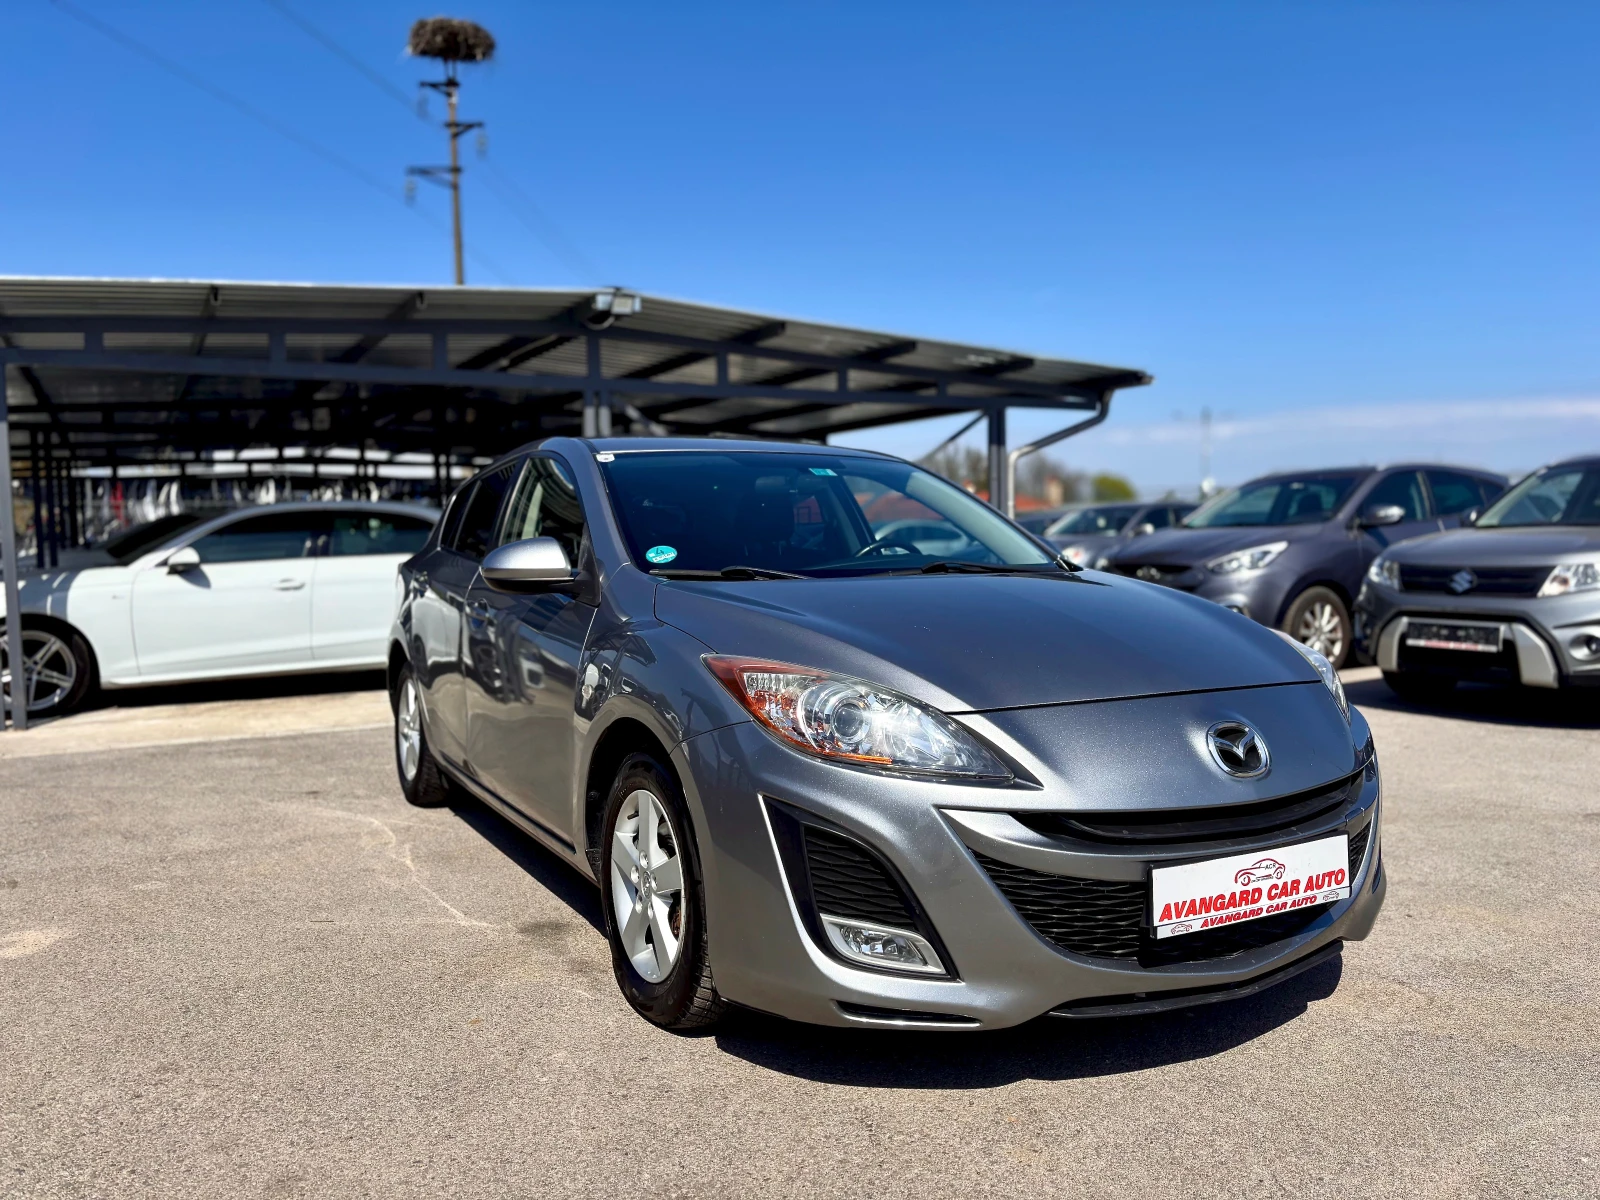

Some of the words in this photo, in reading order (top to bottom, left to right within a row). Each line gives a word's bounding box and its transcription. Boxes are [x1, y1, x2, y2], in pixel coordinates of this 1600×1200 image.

[1158, 887, 1263, 922] AVANGARD
[1267, 879, 1301, 901] CAR
[1303, 868, 1346, 893] AUTO
[1200, 907, 1263, 928] AVANGARD
[1266, 901, 1288, 914] CAR
[1289, 895, 1317, 909] AUTO
